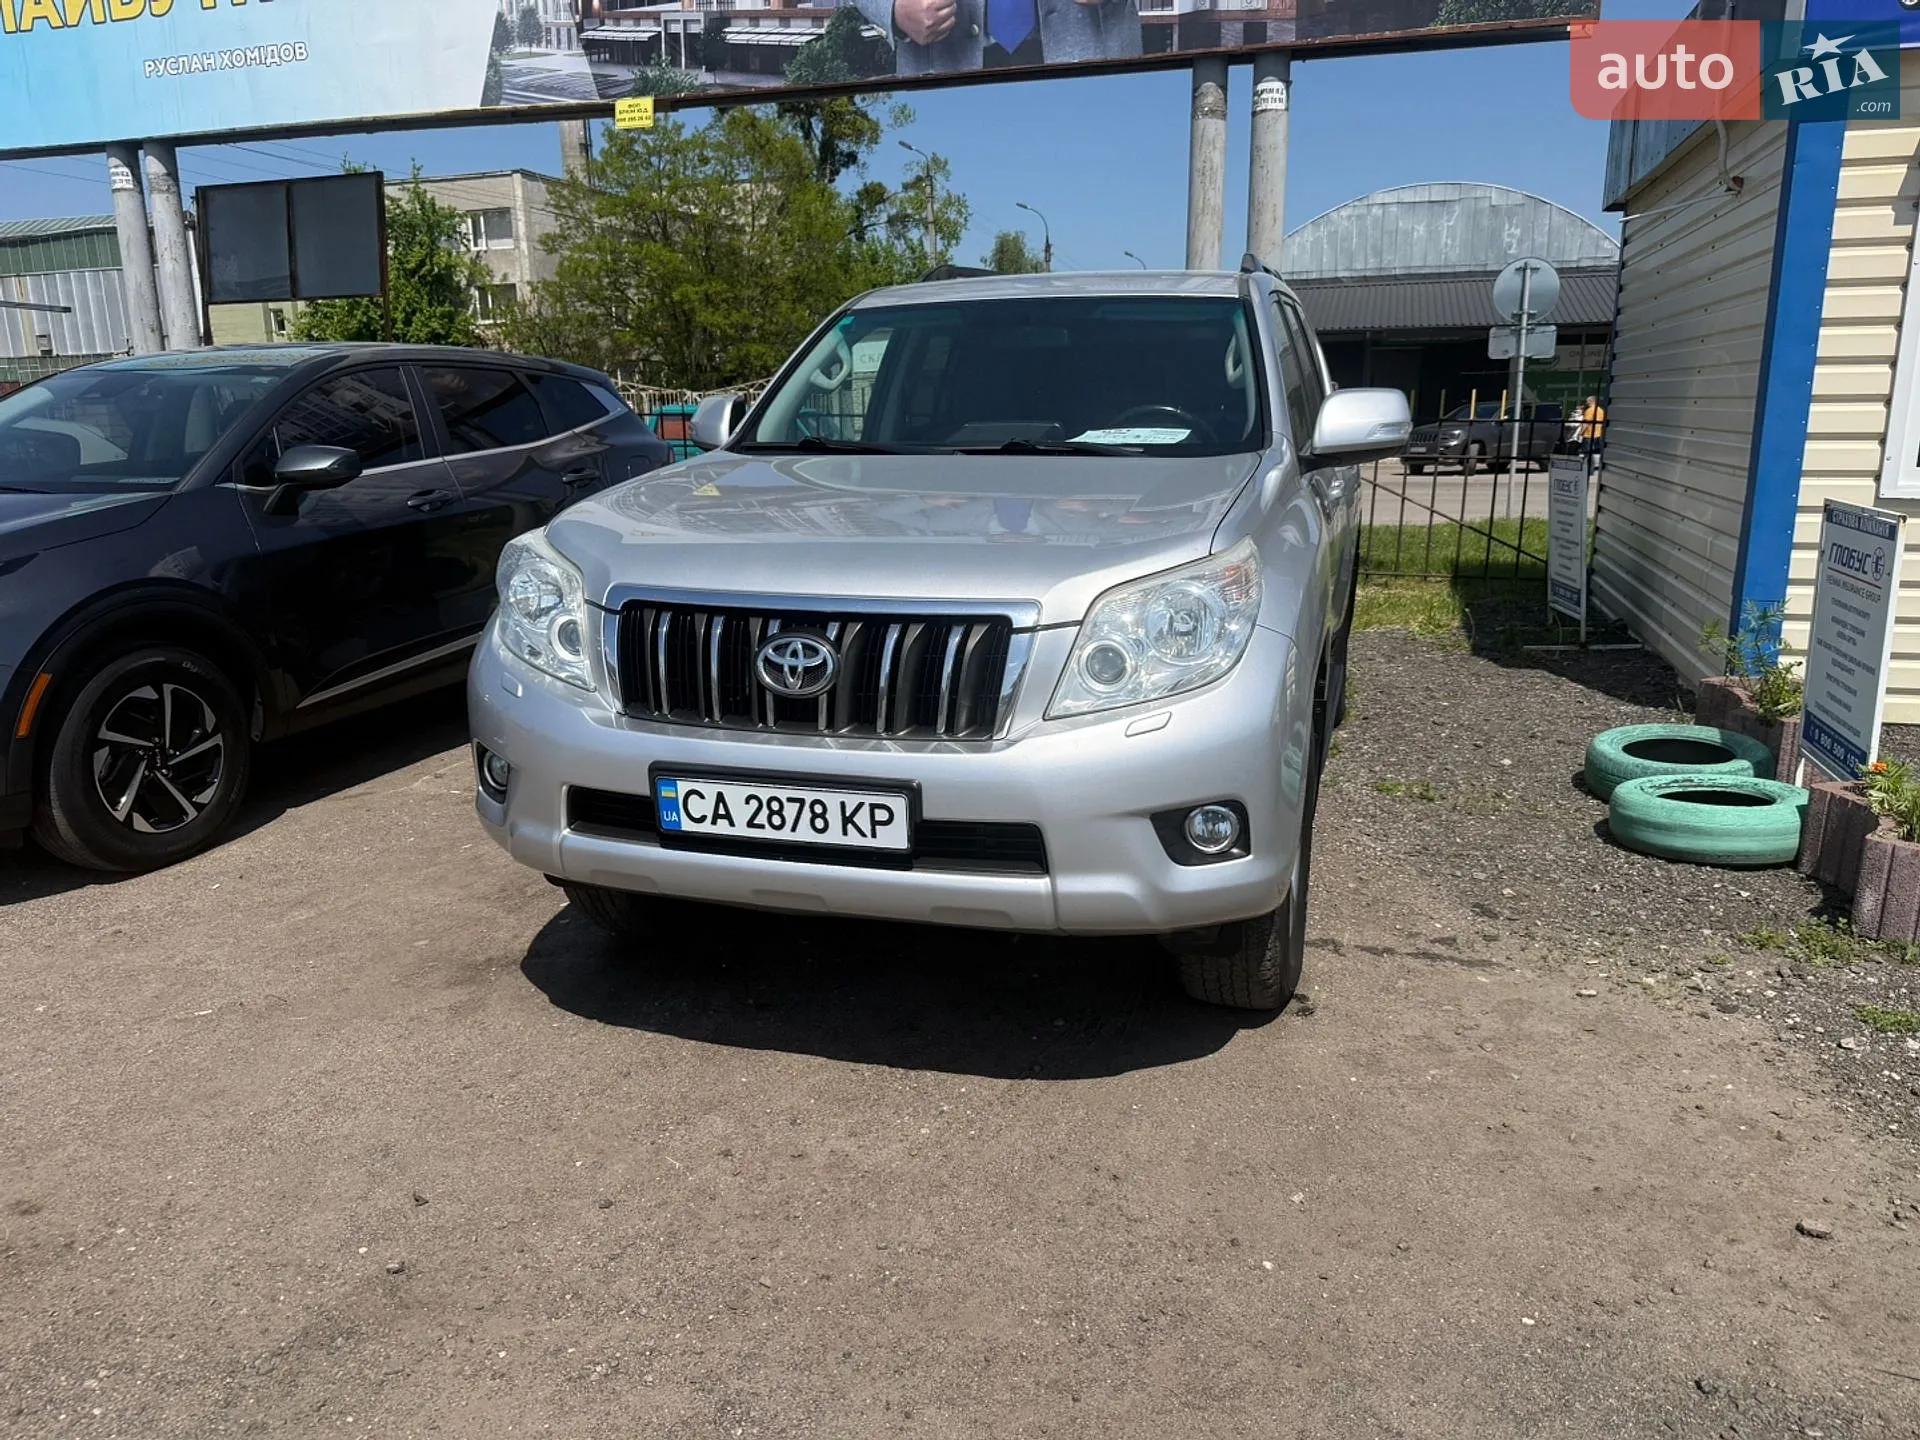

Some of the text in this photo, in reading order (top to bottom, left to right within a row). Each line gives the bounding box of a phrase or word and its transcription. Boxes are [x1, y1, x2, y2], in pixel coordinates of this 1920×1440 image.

[143, 41, 308, 78] РУСЛАН ХОМІДОВ
[1828, 542, 1872, 575] ГЛОБУС
[663, 788, 895, 839] UA CA 2878 KP
